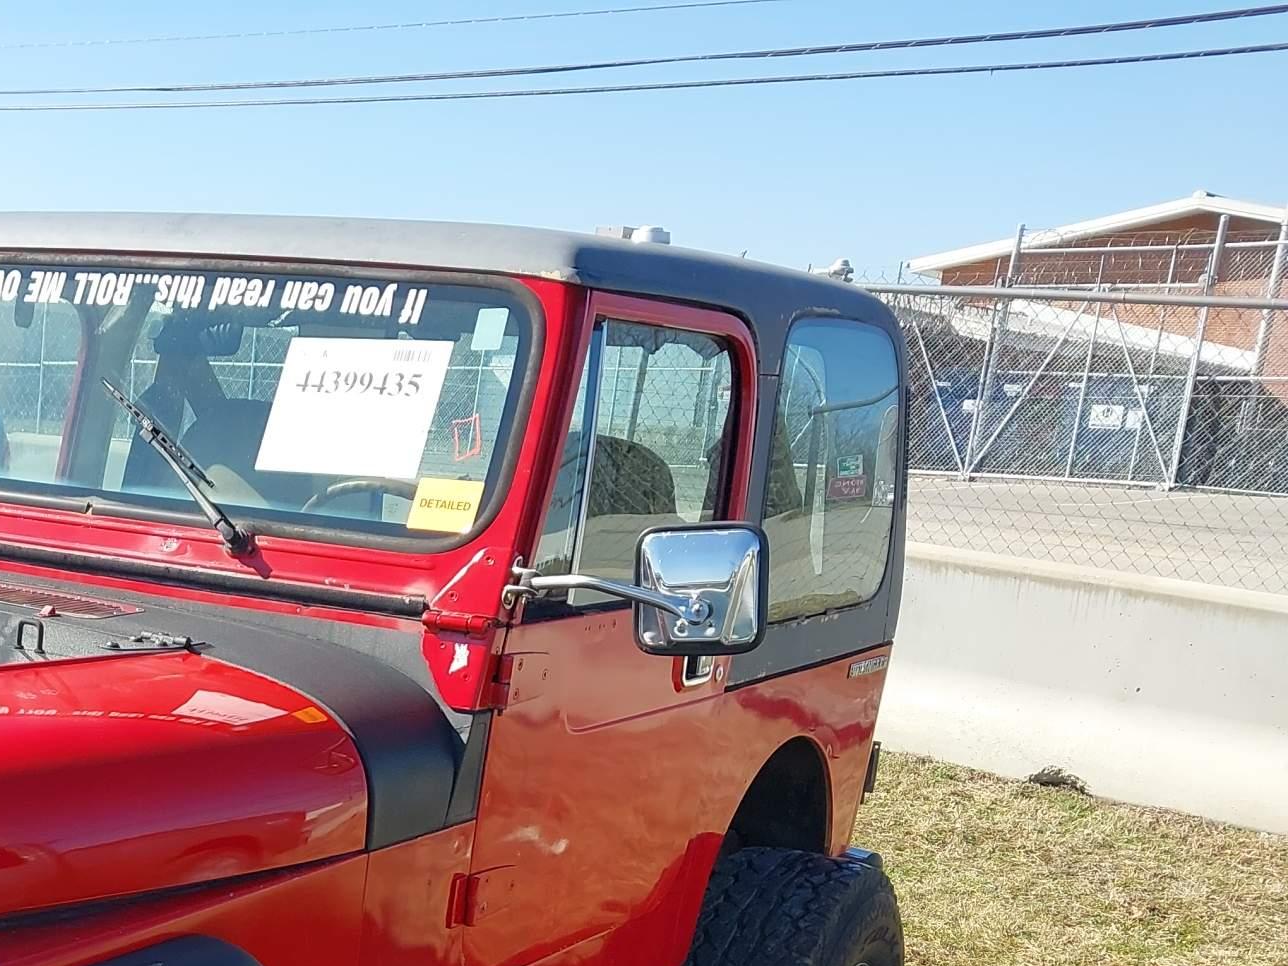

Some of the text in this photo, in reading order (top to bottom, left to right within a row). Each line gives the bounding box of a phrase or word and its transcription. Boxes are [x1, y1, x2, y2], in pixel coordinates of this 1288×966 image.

[24, 271, 67, 303] ME
[208, 277, 276, 310] read
[280, 280, 335, 312] can
[340, 283, 398, 316] you
[398, 288, 427, 324] If
[295, 370, 423, 397] 44399435
[419, 498, 471, 511] DETAILED
